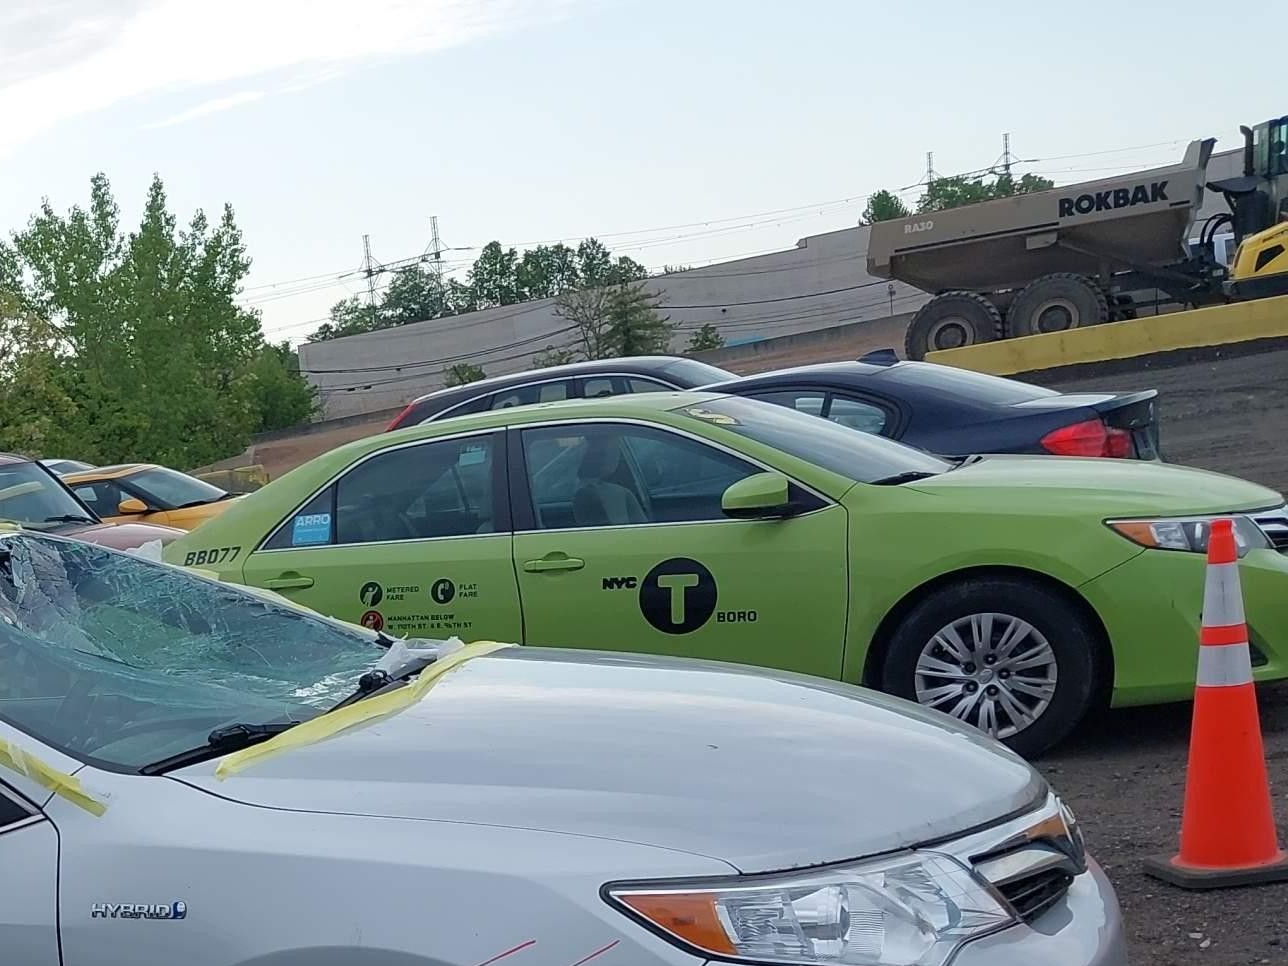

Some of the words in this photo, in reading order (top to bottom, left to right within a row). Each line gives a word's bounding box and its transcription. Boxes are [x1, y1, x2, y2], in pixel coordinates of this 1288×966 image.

[1058, 180, 1169, 218] ROKBAK
[904, 220, 934, 234] RA30
[296, 514, 329, 528] ARRO
[184, 547, 241, 567] BB077
[602, 577, 638, 590] NYC
[459, 590, 478, 598] FARE
[657, 573, 700, 625] T
[716, 610, 757, 623] BORO
[91, 903, 171, 919] HYBRID
